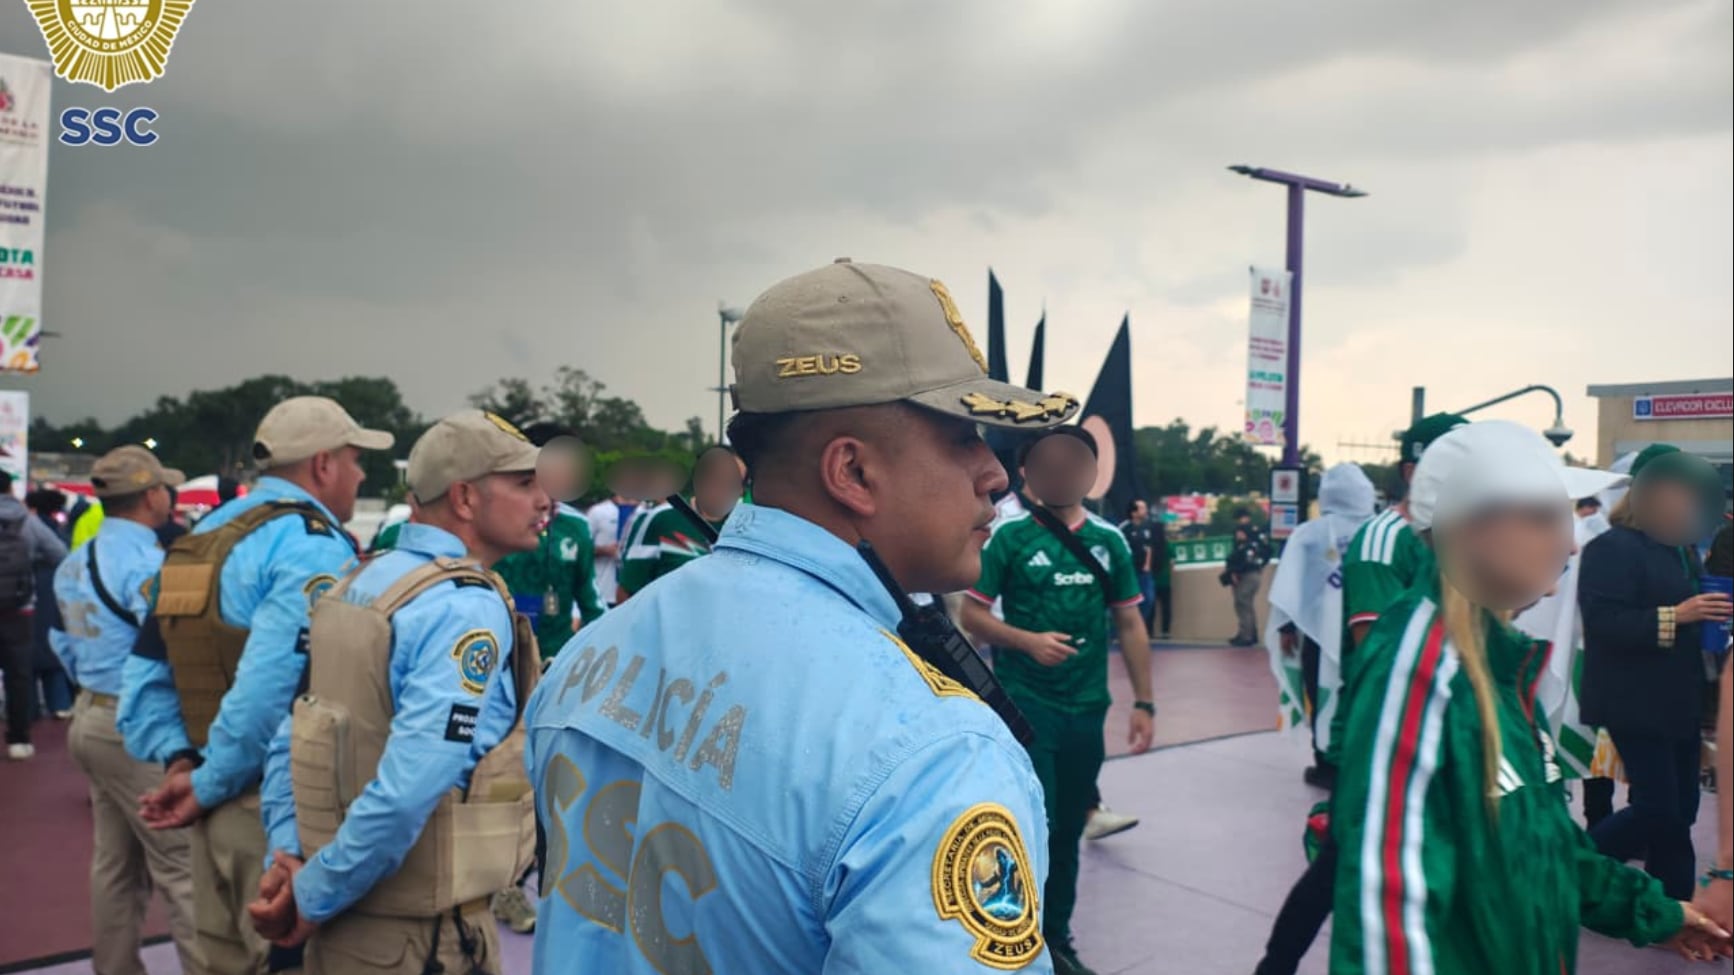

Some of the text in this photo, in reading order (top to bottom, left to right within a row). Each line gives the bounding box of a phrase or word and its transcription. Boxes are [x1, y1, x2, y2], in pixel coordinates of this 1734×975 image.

[776, 354, 862, 377] ZEUS
[1054, 571, 1094, 586] Scribe
[557, 645, 745, 792] POLICÍA
[539, 752, 718, 975] SSC
[993, 938, 1033, 957] ZEUS
